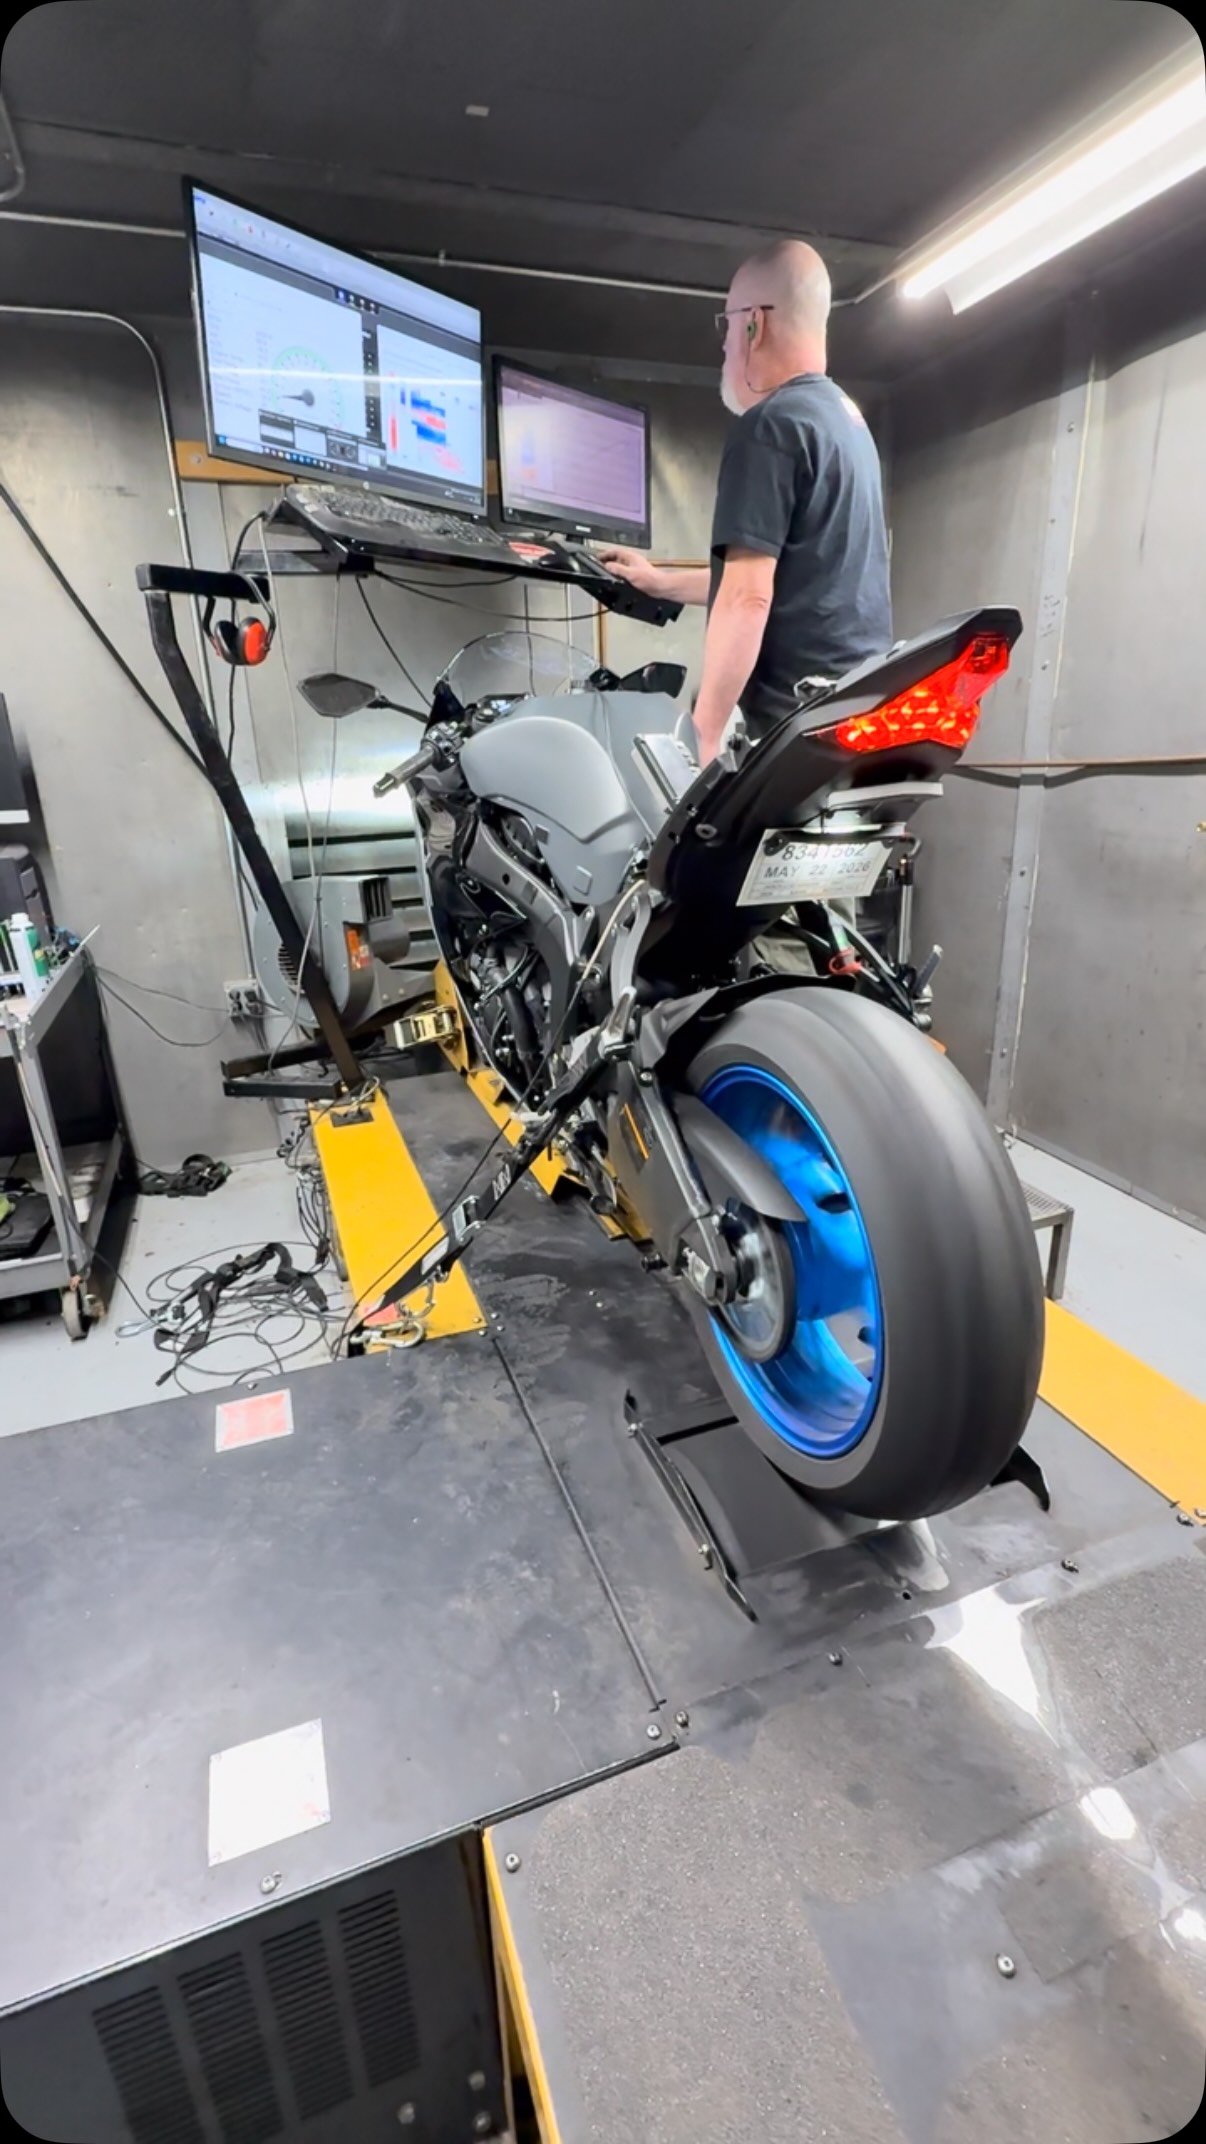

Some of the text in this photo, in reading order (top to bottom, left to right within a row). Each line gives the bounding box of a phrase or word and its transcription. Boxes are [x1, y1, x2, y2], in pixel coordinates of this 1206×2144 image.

[764, 860, 872, 878] MAY 22 2026
